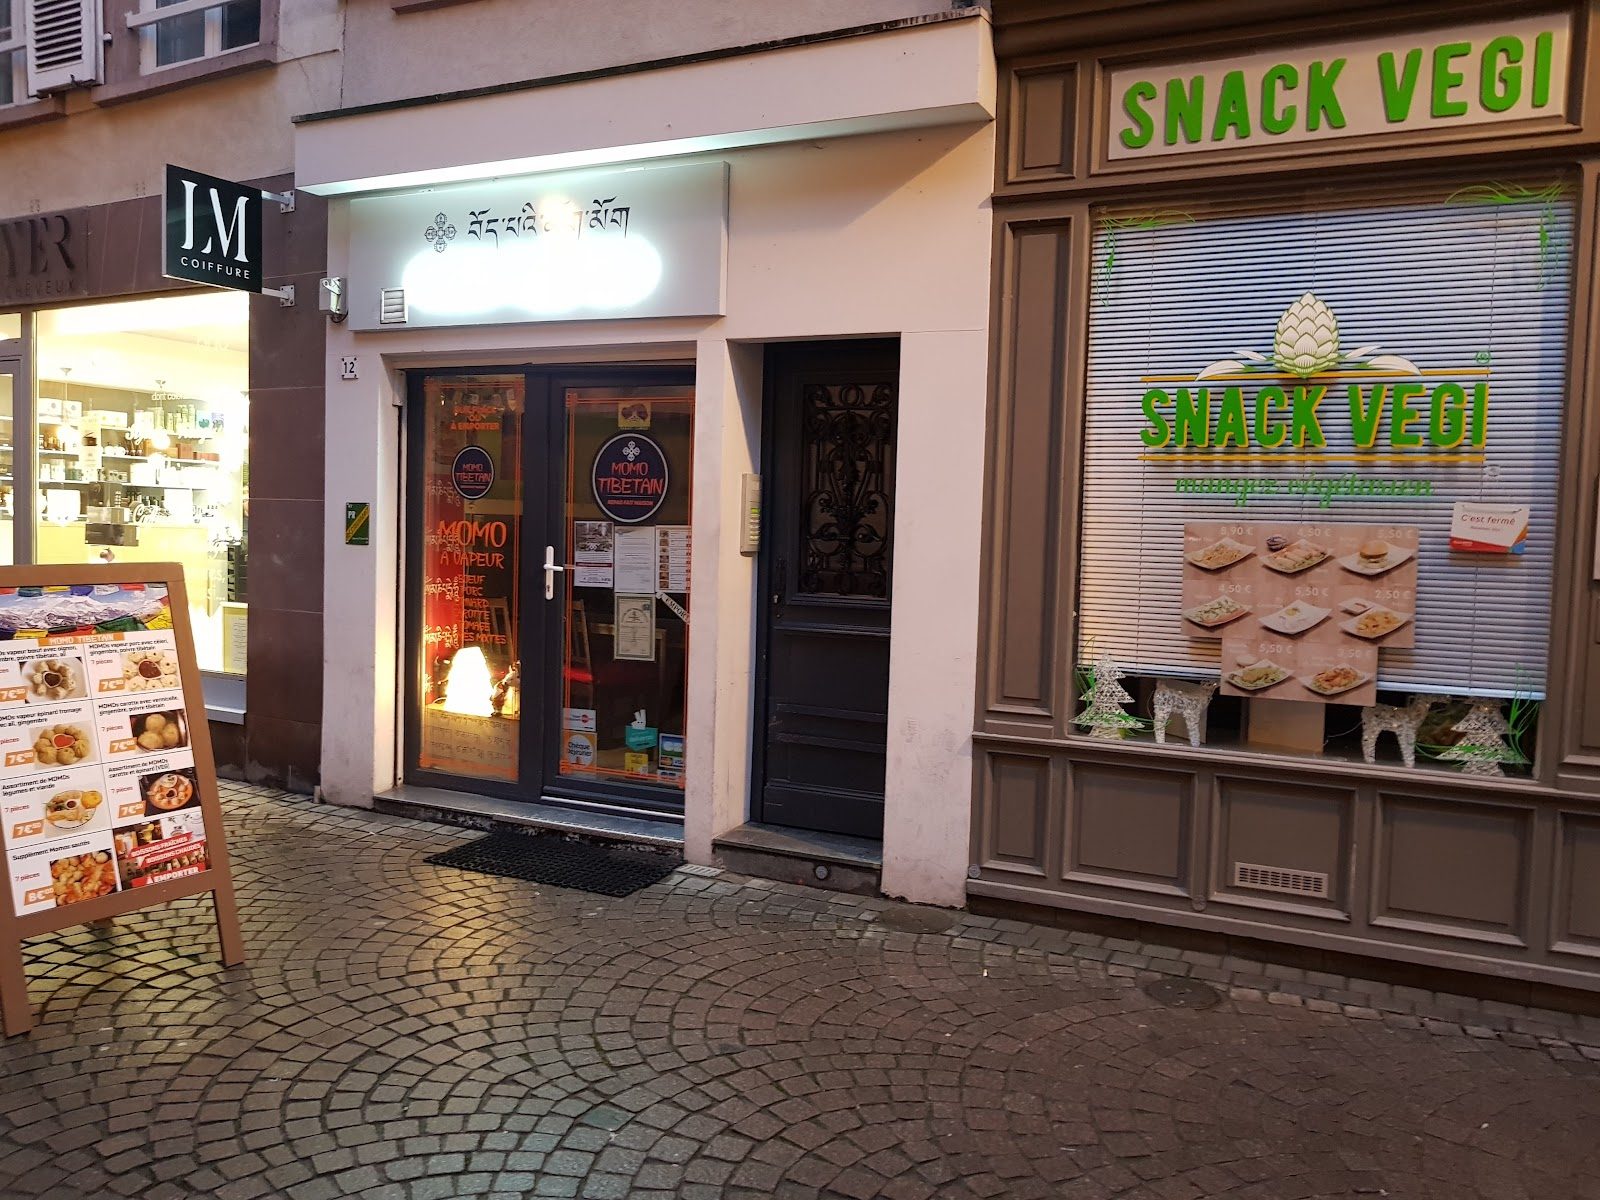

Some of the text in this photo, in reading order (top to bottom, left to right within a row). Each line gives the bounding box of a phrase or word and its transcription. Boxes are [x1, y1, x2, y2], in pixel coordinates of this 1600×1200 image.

[1119, 31, 1554, 149] SNACK VEGI
[181, 256, 250, 280] COIFFURE
[344, 361, 355, 374] 12
[1140, 382, 1489, 449] SNACK VEGI
[462, 463, 483, 472] MOMO
[612, 462, 648, 475] MOMO
[456, 472, 492, 482] TIBETAIN
[598, 477, 664, 494] TIBETAIN
[1462, 514, 1516, 525] C'est fermé
[440, 520, 507, 548] MOMO
[454, 551, 504, 569] VAPEUR
[49, 637, 74, 645] MOMO
[2, 780, 39, 790] Assortiment
[153, 867, 199, 883] EMPORTER
